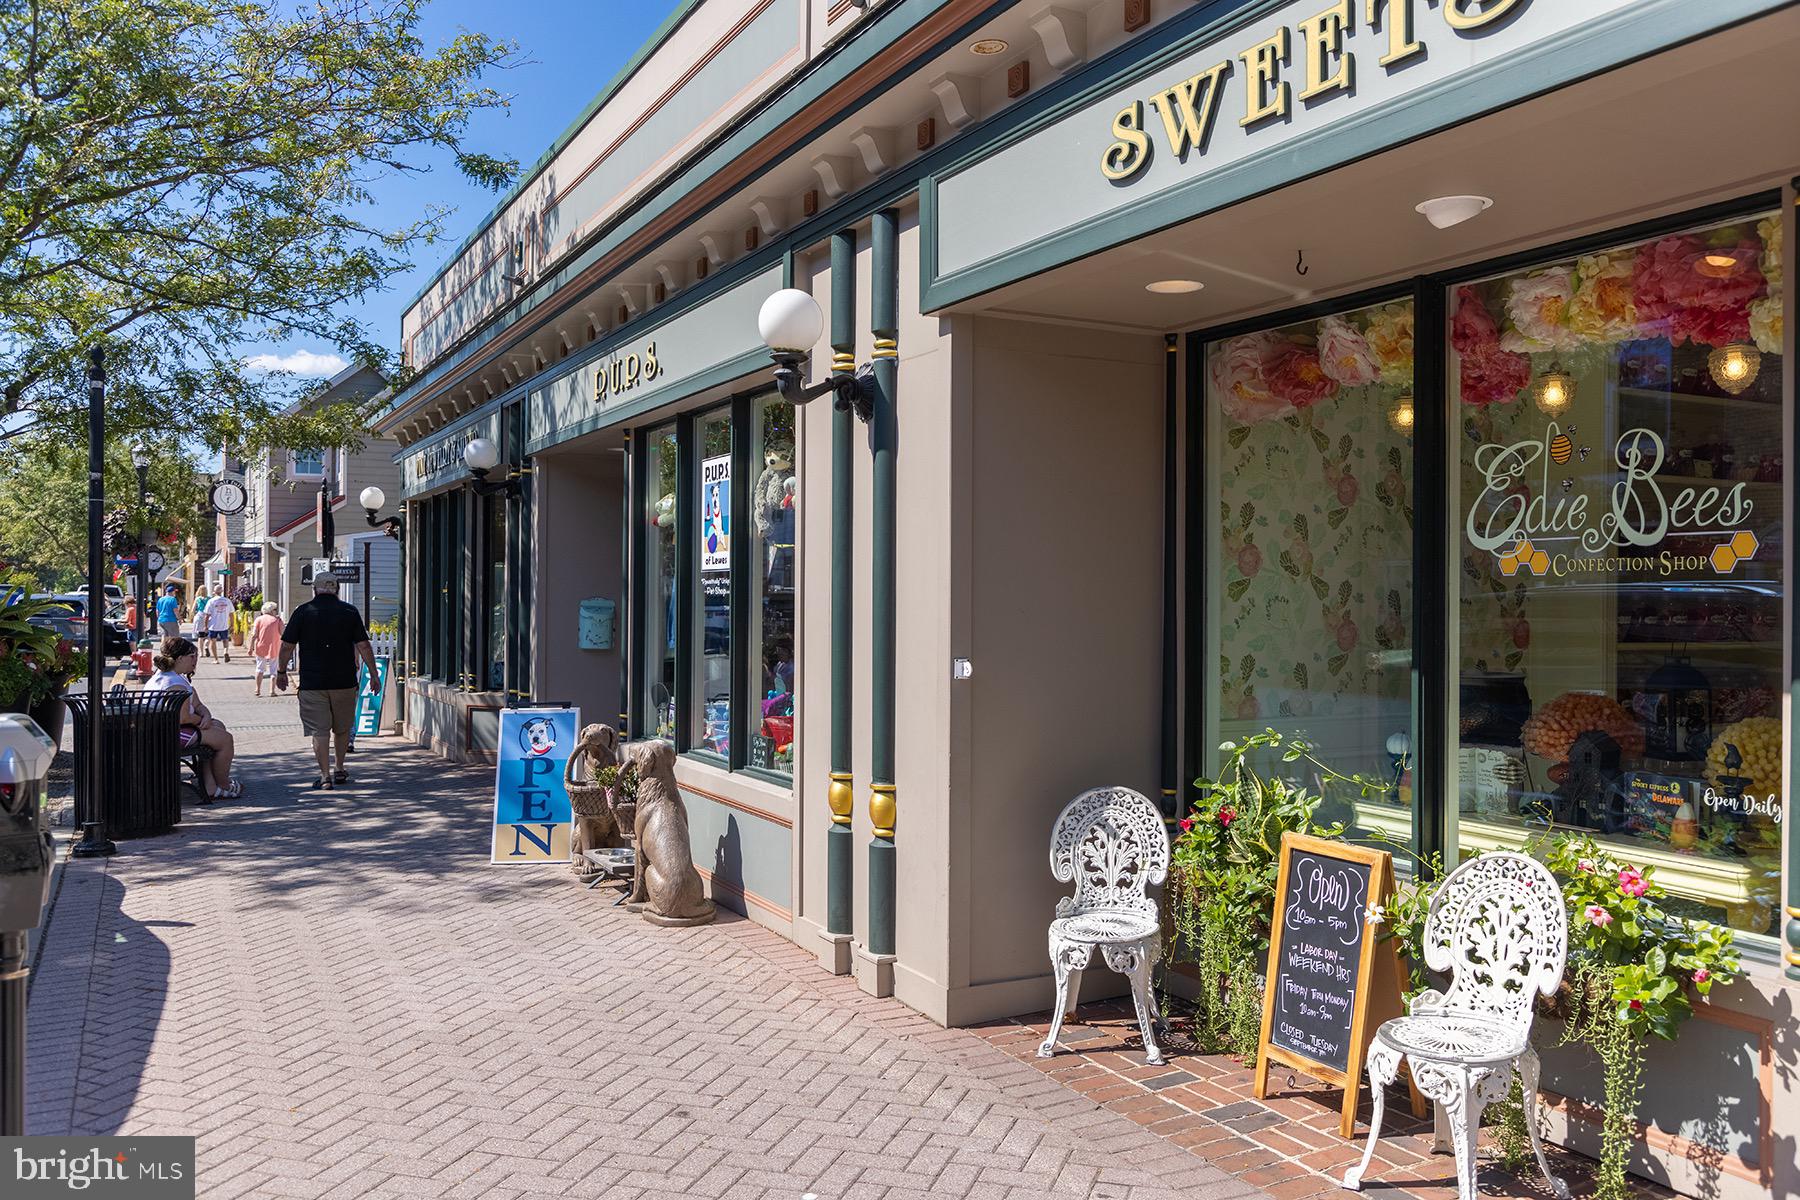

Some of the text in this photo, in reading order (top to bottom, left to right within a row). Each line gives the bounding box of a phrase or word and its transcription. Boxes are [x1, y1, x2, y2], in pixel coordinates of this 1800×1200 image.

[1467, 422, 1754, 559] Edie Bees
[314, 561, 327, 572] ONE
[705, 556, 728, 565] of Lewes
[1704, 788, 1783, 823] Open Daily
[1293, 907, 1316, 924] 10am
[1328, 916, 1347, 930] 5pm
[1301, 942, 1338, 964] LABOR DAY
[1289, 952, 1351, 983] WEEKEND HRS
[1280, 1022, 1339, 1057] CLOSED TUESDAY
